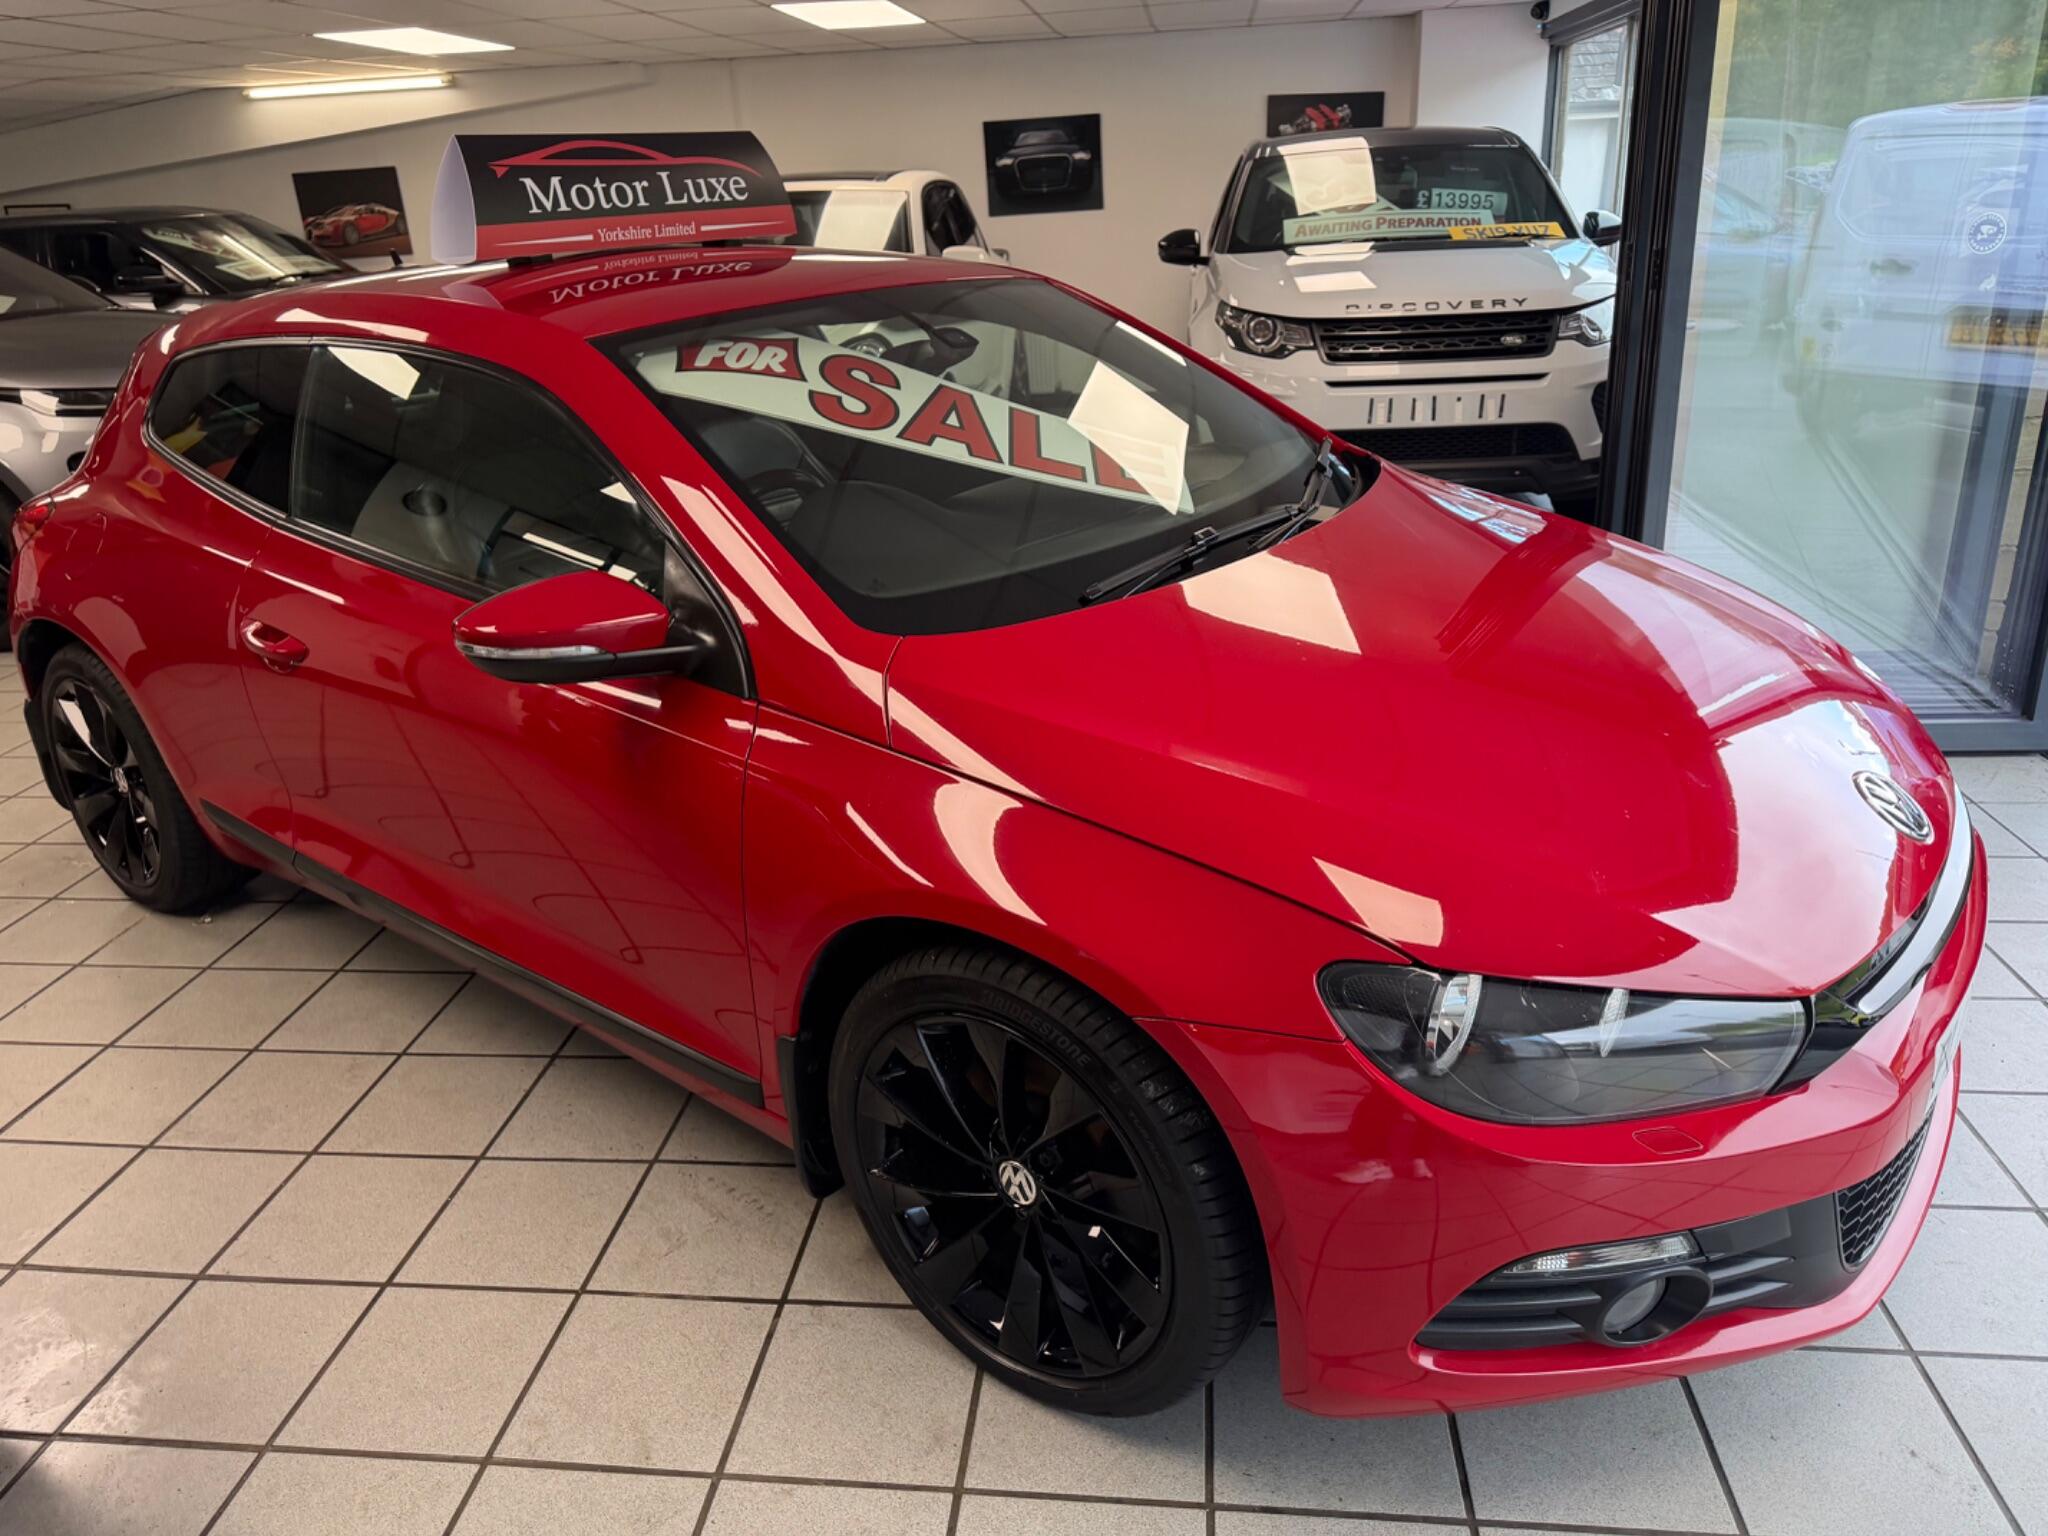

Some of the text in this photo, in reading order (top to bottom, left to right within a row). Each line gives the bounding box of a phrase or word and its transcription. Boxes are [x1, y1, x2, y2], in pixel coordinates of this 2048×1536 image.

[519, 171, 749, 213] Motor Luxe
[597, 221, 696, 242] Yorkshire Limited
[1345, 297, 1528, 312] DISCOVERY
[694, 341, 790, 374] FOR
